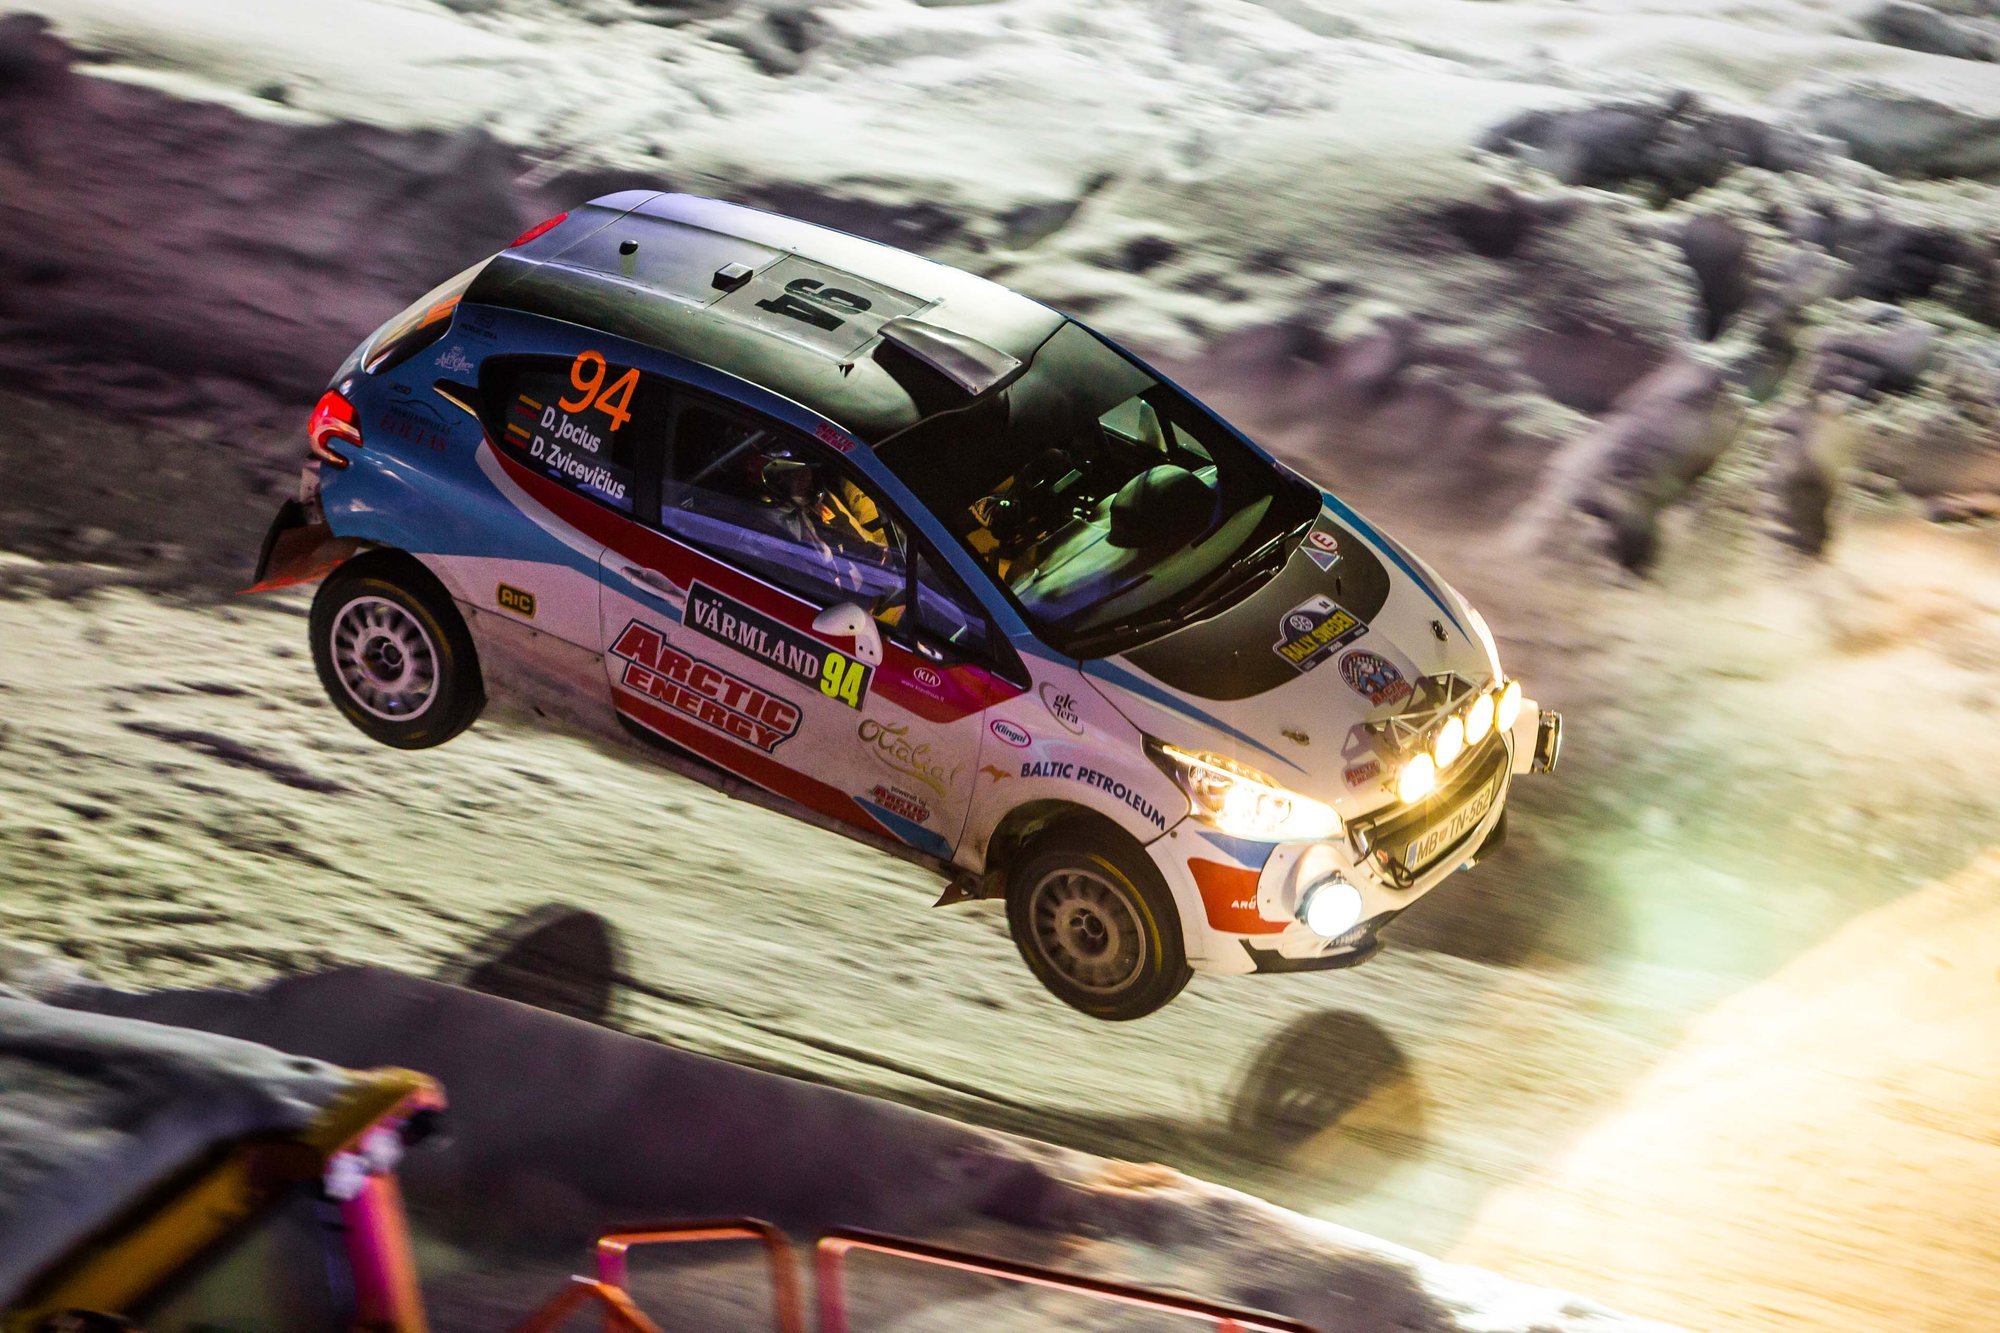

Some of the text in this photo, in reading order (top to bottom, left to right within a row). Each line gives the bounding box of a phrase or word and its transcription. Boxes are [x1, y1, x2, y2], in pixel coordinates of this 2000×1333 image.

[755, 278, 872, 332] 94
[558, 350, 641, 432] 94
[540, 405, 602, 453] D. Jocius
[530, 435, 627, 500] D. Zvicevičius
[694, 598, 865, 709] VÄRMLAND 94
[1281, 609, 1356, 663] RALLY SWEDEN
[611, 620, 800, 736] ARCTIC
[623, 662, 784, 753] ENERGY
[917, 669, 936, 686] KIA
[1020, 761, 1166, 831] BALTIC PETROLEUM
[1416, 788, 1491, 862] MB TN-562
